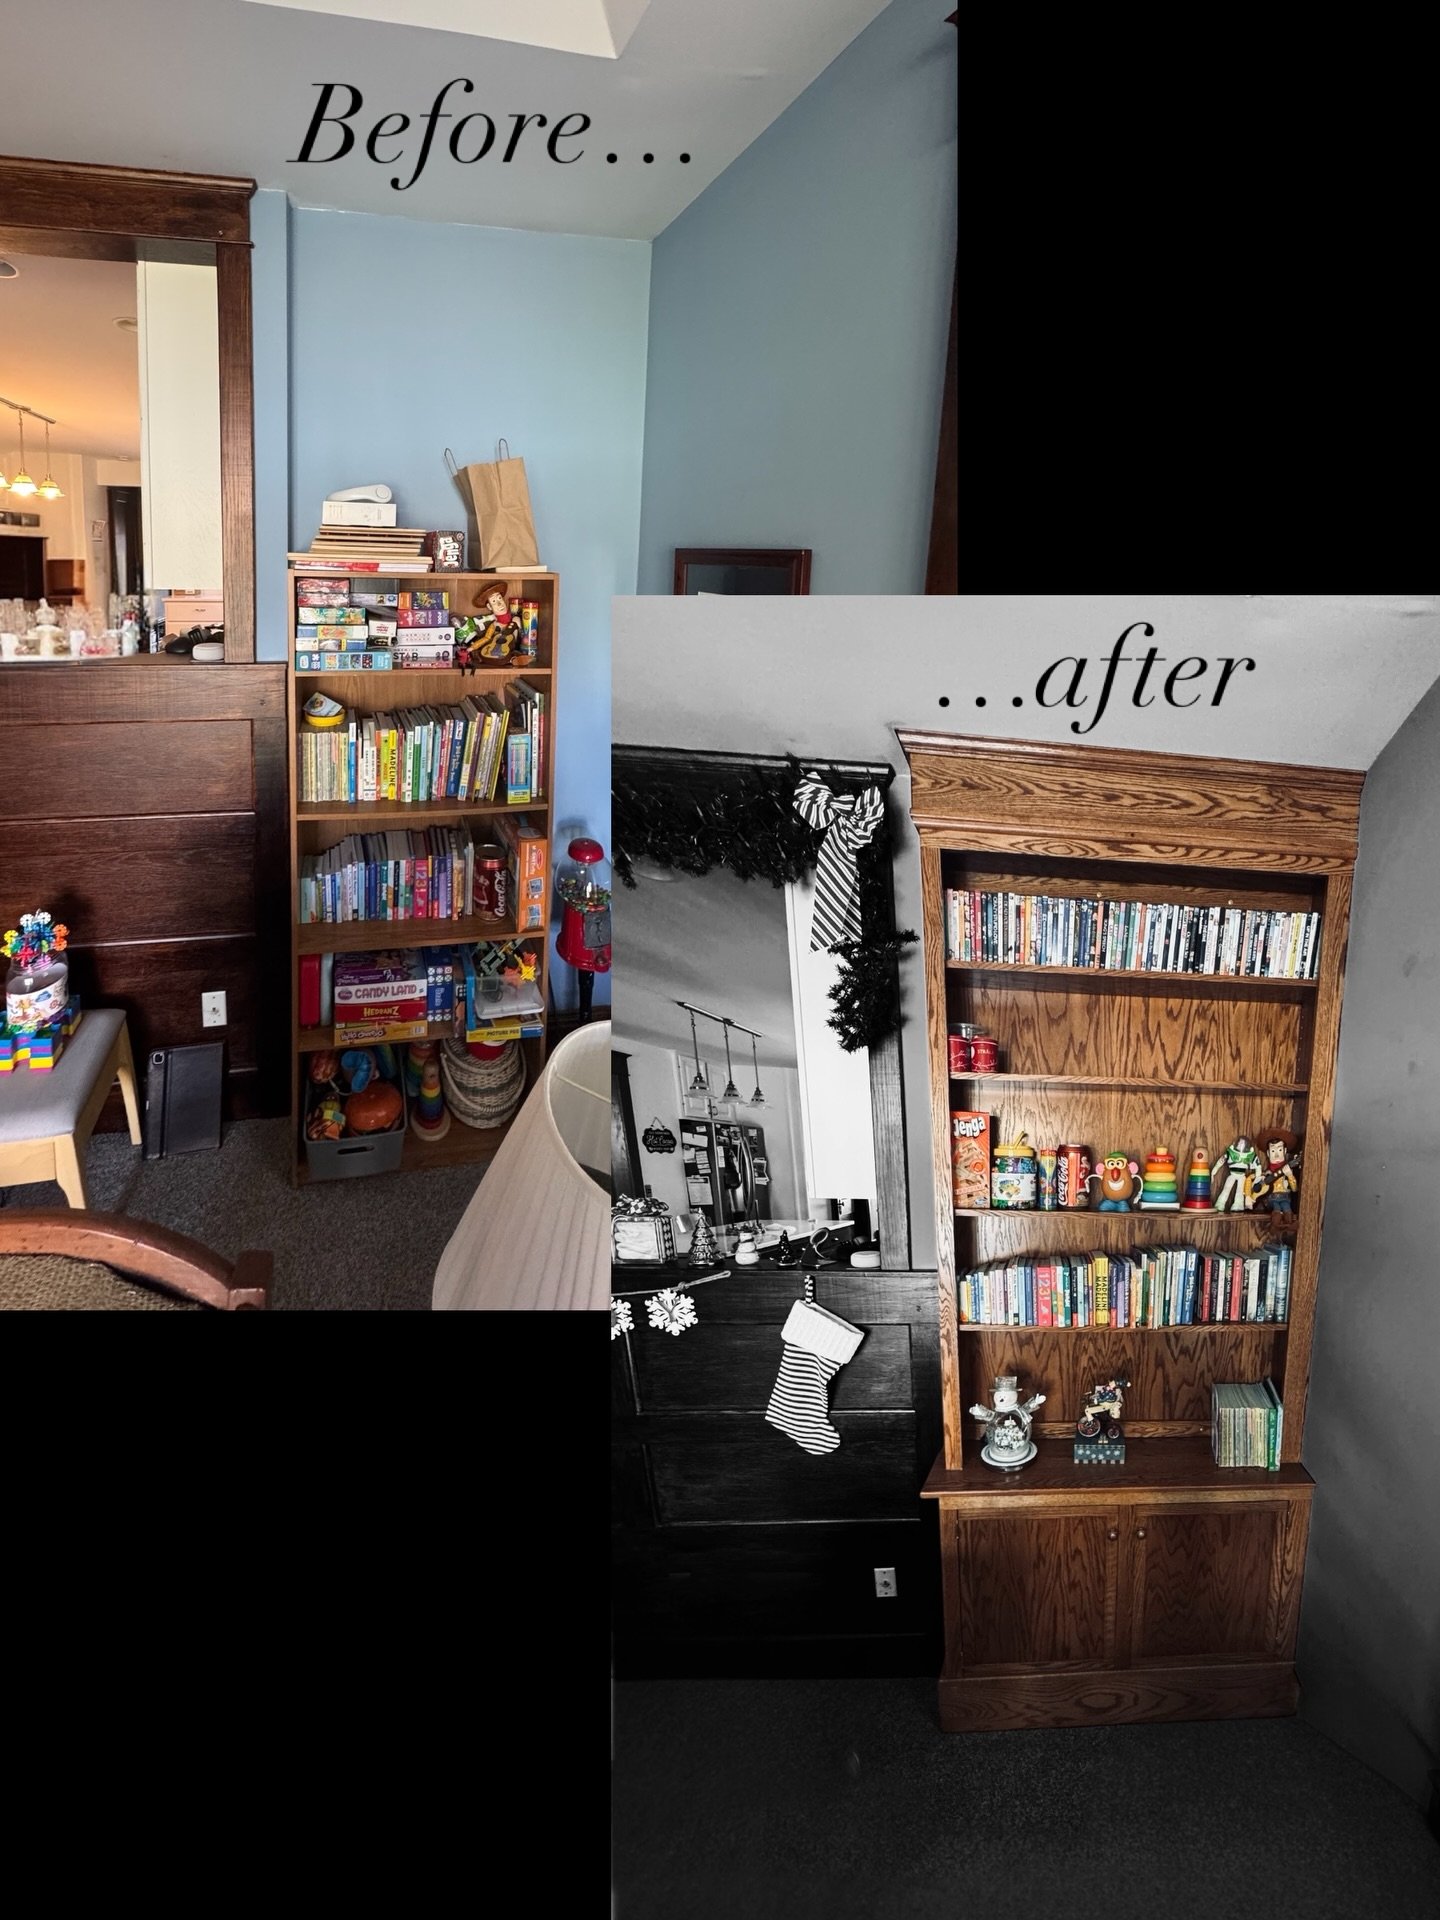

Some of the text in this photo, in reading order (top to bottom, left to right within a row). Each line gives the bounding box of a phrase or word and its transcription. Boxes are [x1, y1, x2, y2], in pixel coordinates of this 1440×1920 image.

[439, 536, 460, 566] Jenga
[354, 986, 390, 999] CANDY
[391, 984, 417, 996] LAND
[953, 1117, 986, 1137] Jenga
